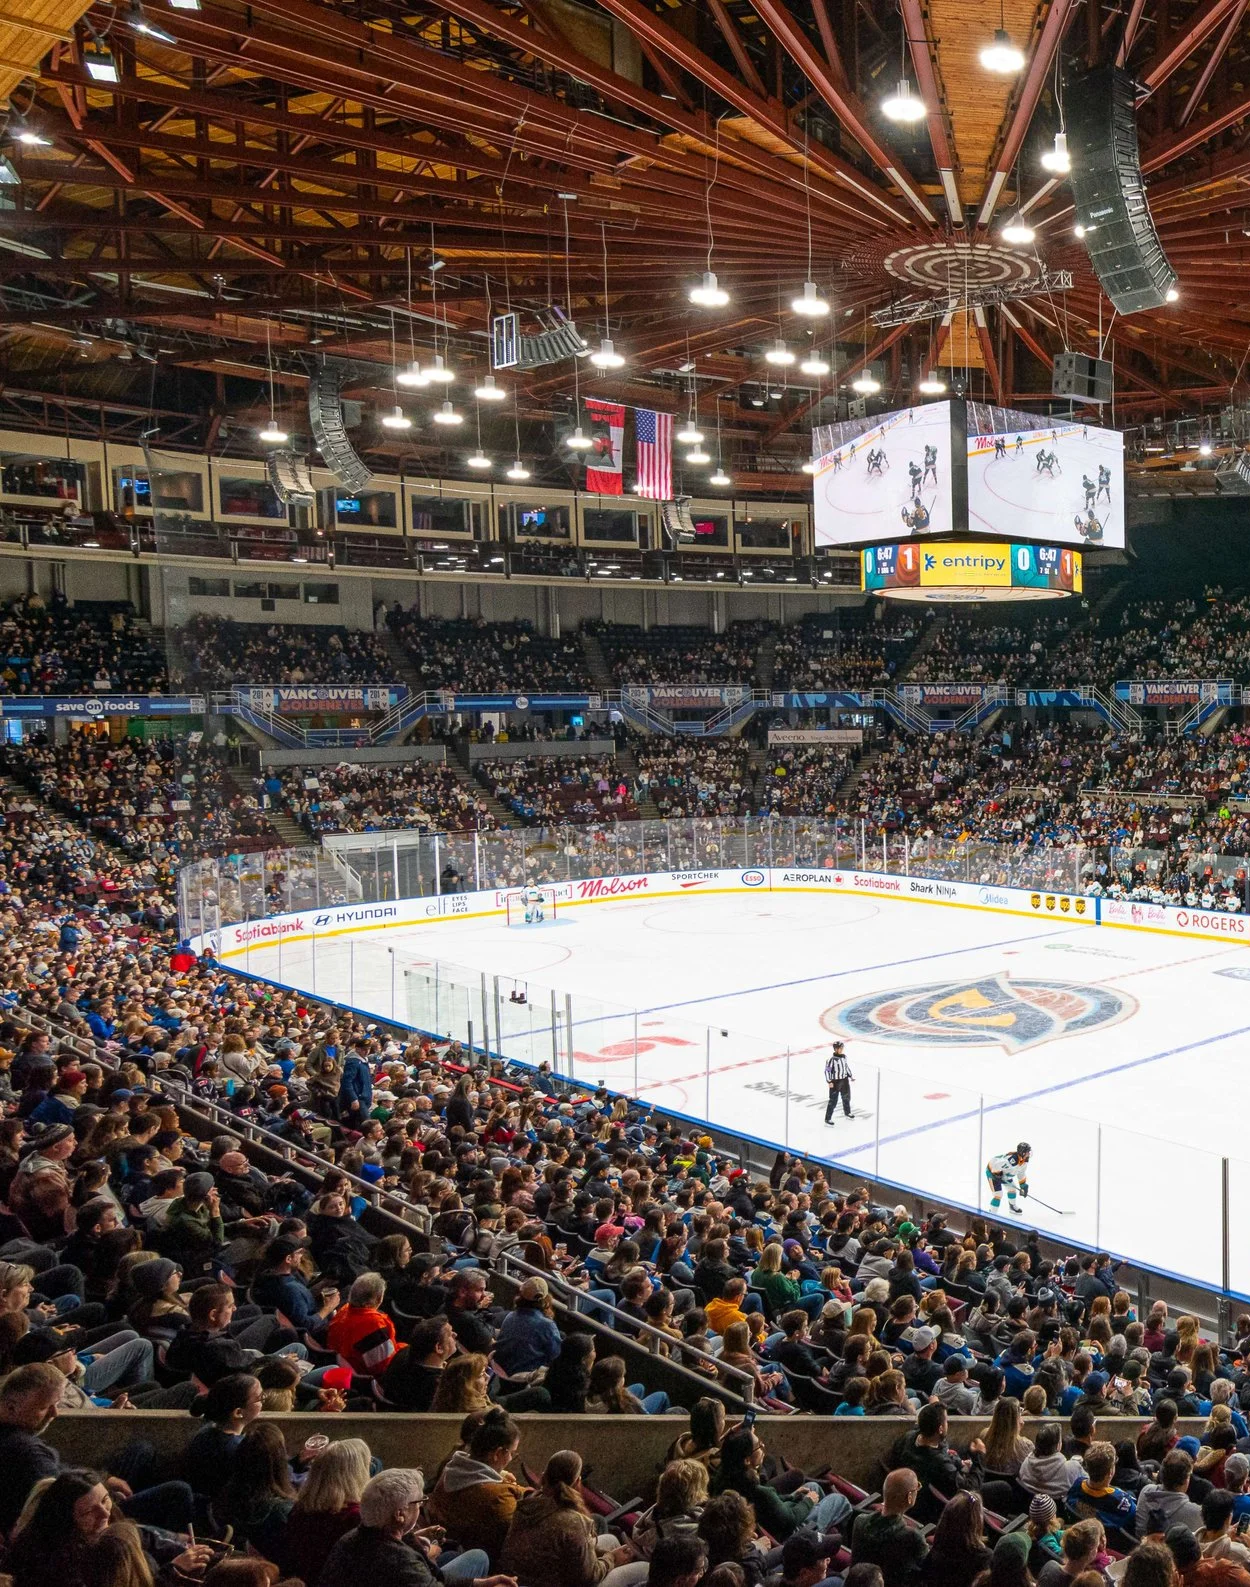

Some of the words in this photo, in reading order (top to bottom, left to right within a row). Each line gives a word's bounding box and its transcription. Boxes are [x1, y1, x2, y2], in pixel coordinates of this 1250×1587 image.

[877, 547, 893, 560] 6:47
[904, 548, 912, 570] 1
[1018, 548, 1030, 570] 0
[1040, 548, 1056, 561] 6:47
[943, 554, 1006, 570] entripy
[1065, 553, 1070, 574] 1
[279, 689, 364, 699] VANCOUVER
[652, 689, 720, 697] VANCOUVER
[924, 686, 981, 695] VANCOUVER
[1146, 684, 1199, 694] VANCOUVER
[56, 703, 84, 711] save
[87, 702, 102, 711] on
[104, 701, 139, 711] foods
[281, 701, 364, 711] GOLDENEYES
[1146, 695, 1199, 704] GOLDENEYES
[672, 872, 719, 880] SPORTCHEK
[783, 874, 831, 883] AEROPLAN
[578, 876, 648, 898] Molson
[854, 875, 900, 891] Scotiabank
[910, 882, 933, 894] Shark
[426, 897, 448, 916] elf
[337, 907, 397, 922] HYUNDAI
[236, 918, 303, 943] Scotiabank
[1192, 916, 1244, 932] ROGERS
